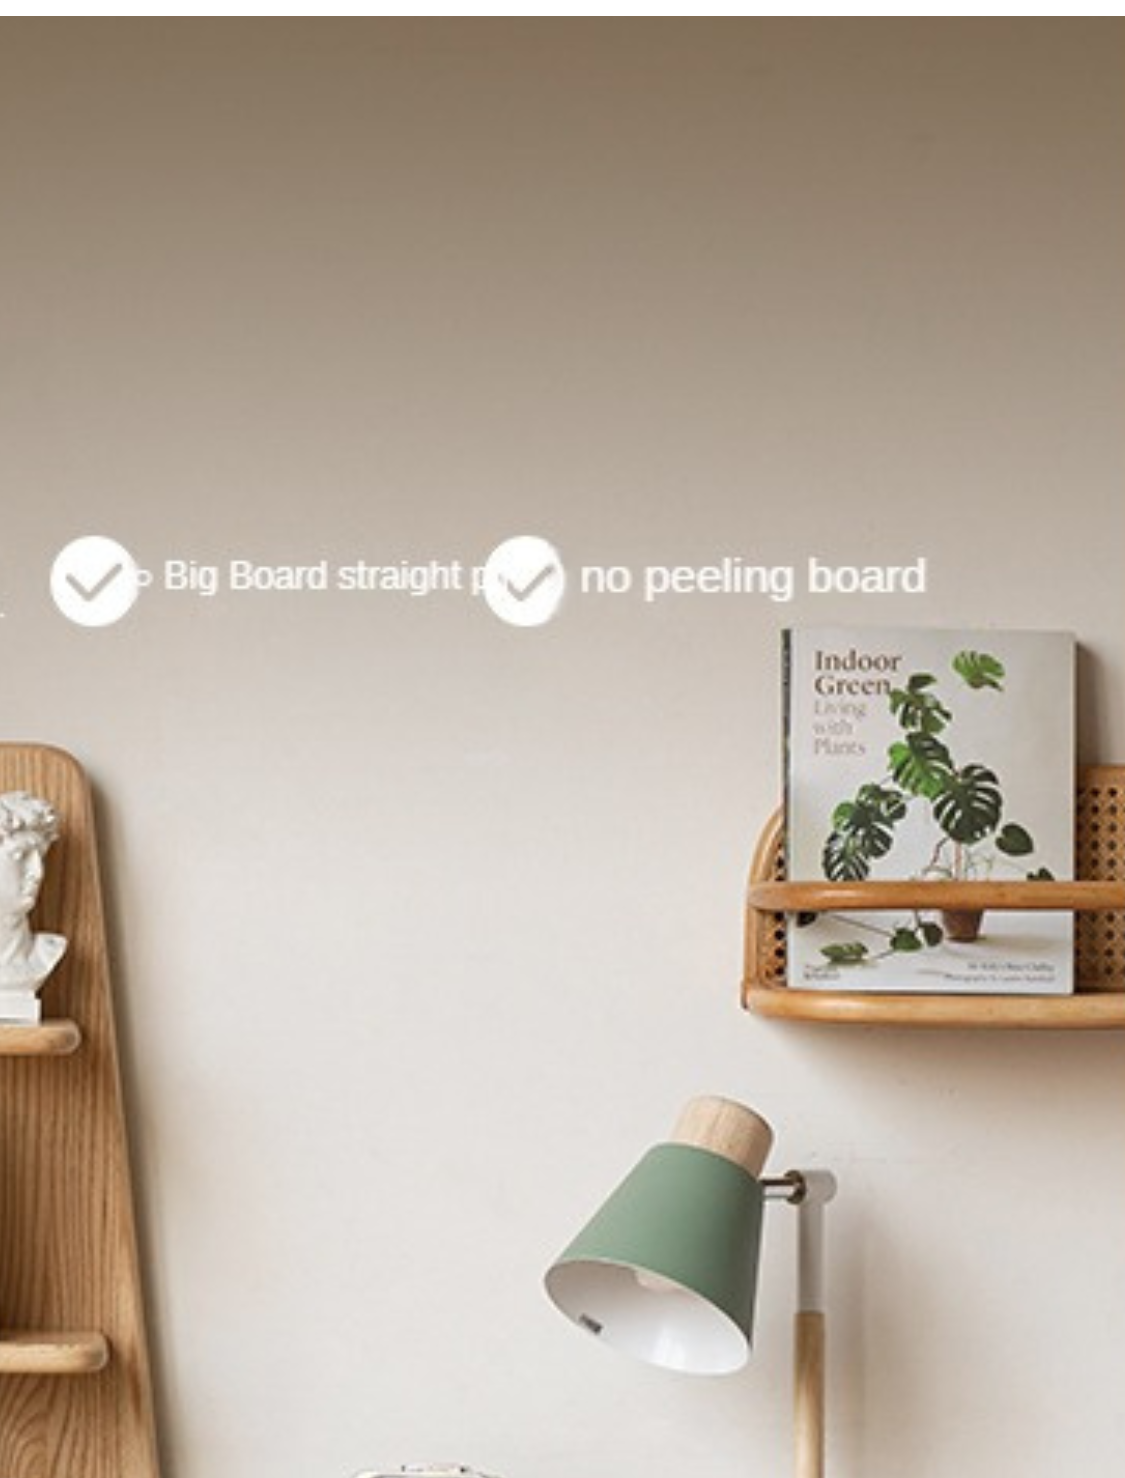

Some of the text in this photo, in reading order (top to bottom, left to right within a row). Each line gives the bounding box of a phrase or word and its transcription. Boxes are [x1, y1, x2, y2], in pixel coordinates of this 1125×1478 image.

[814, 648, 903, 672] Indoor
[813, 675, 892, 697] Green
[814, 698, 867, 721] Living
[812, 718, 854, 736] with
[813, 738, 867, 756] Plants
